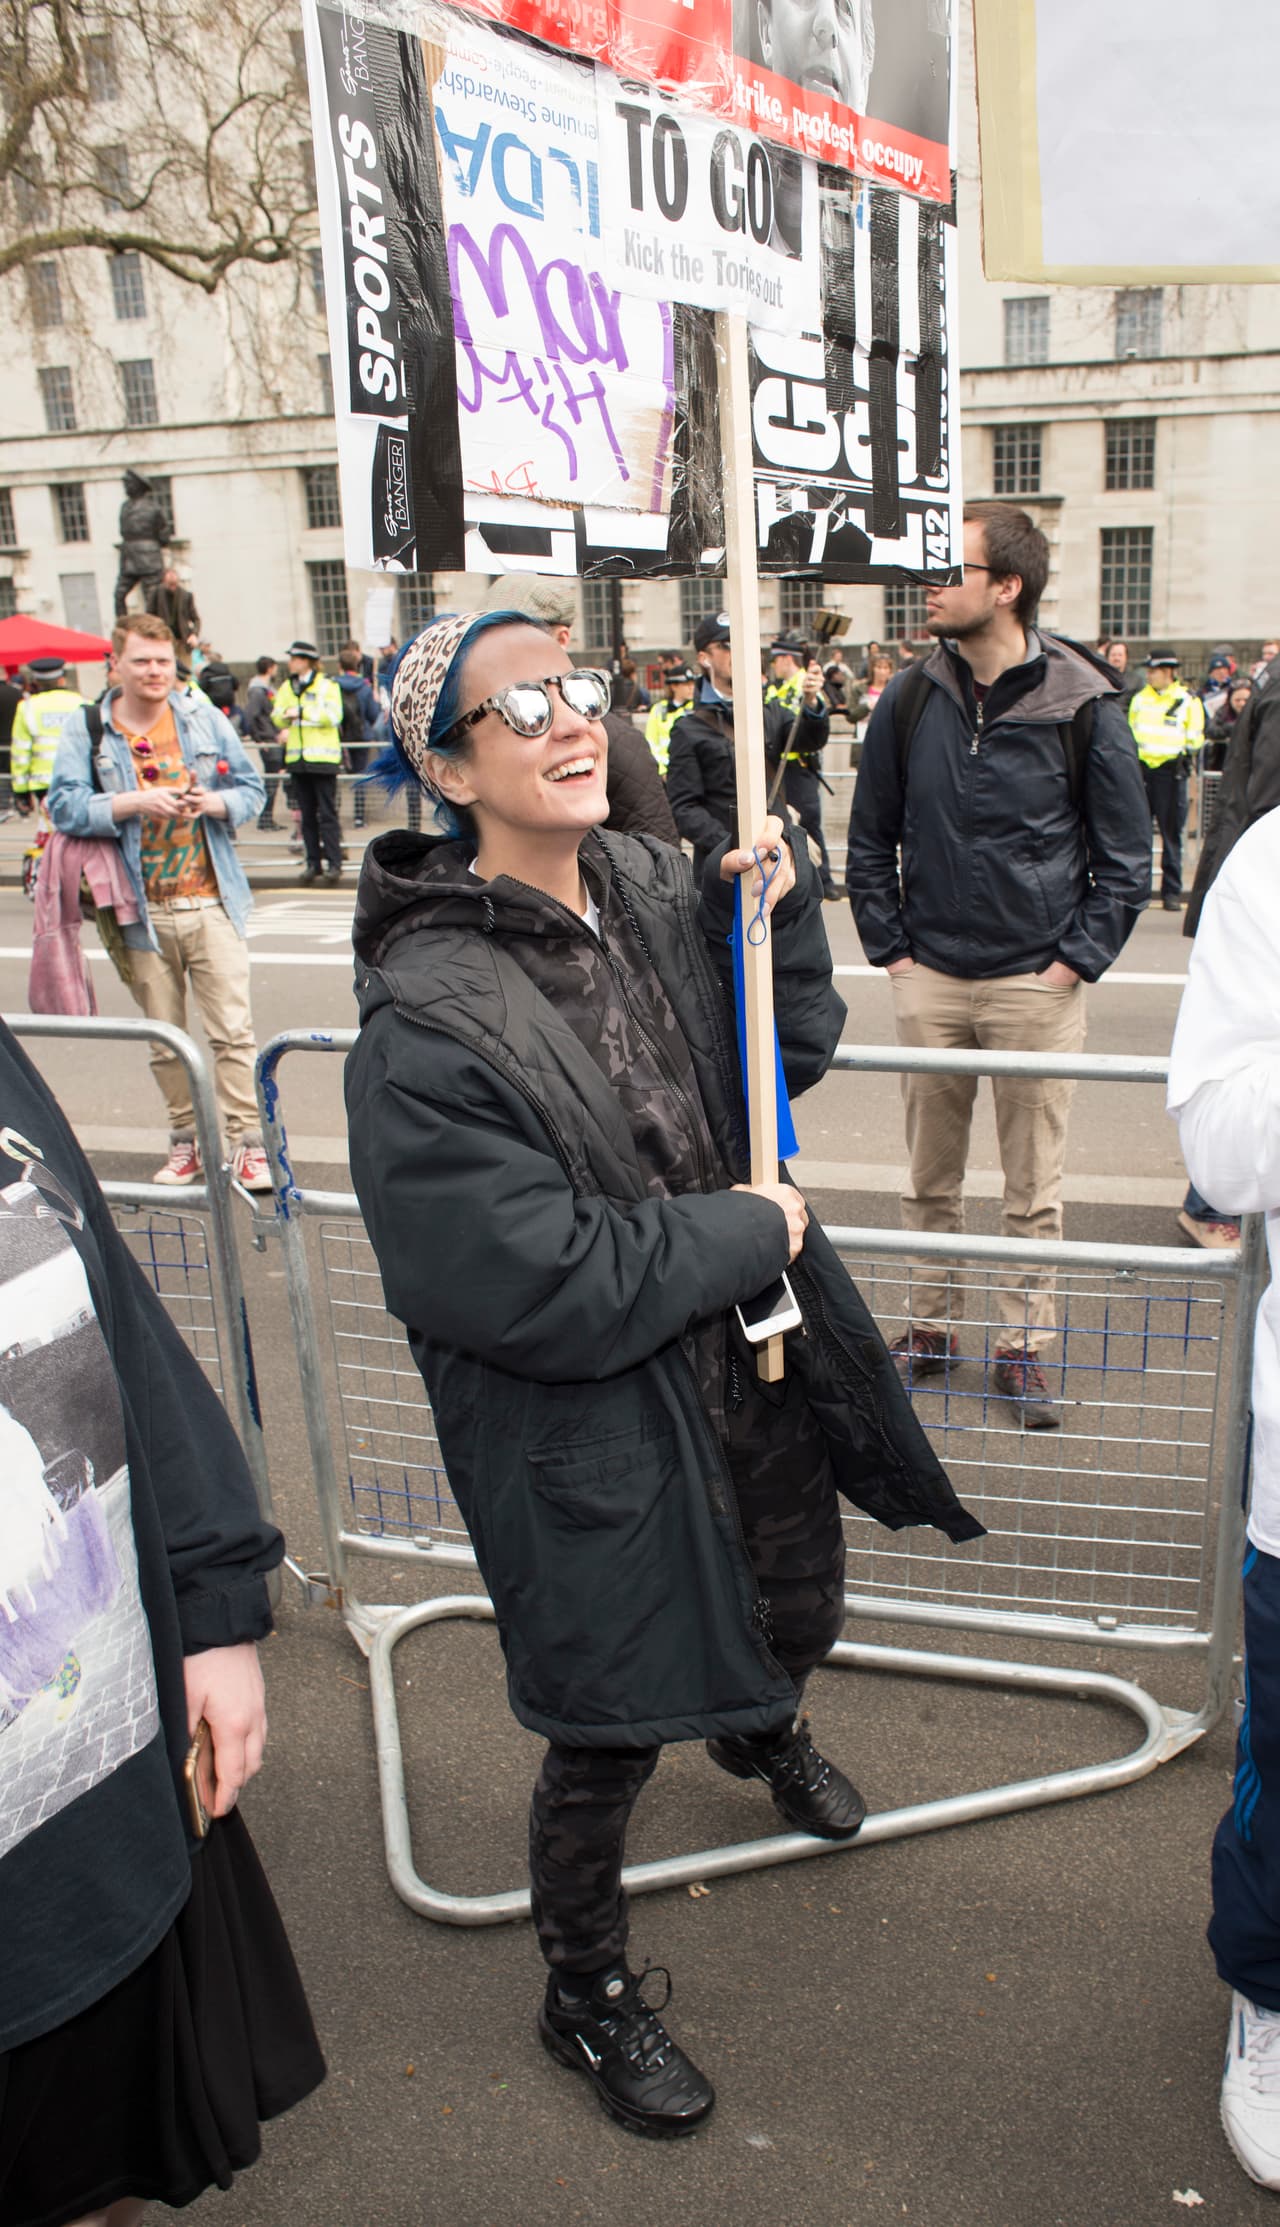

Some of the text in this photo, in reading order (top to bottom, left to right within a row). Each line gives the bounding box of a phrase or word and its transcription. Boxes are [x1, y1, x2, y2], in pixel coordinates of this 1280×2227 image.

[351, 16, 369, 81] BANG
[541, 106, 598, 140] enuine
[734, 73, 789, 133] trike,
[614, 101, 774, 246] TO GO
[338, 113, 398, 402] SPORTS
[623, 228, 784, 309] Kick the Tories out
[391, 445, 407, 521] BANGER
